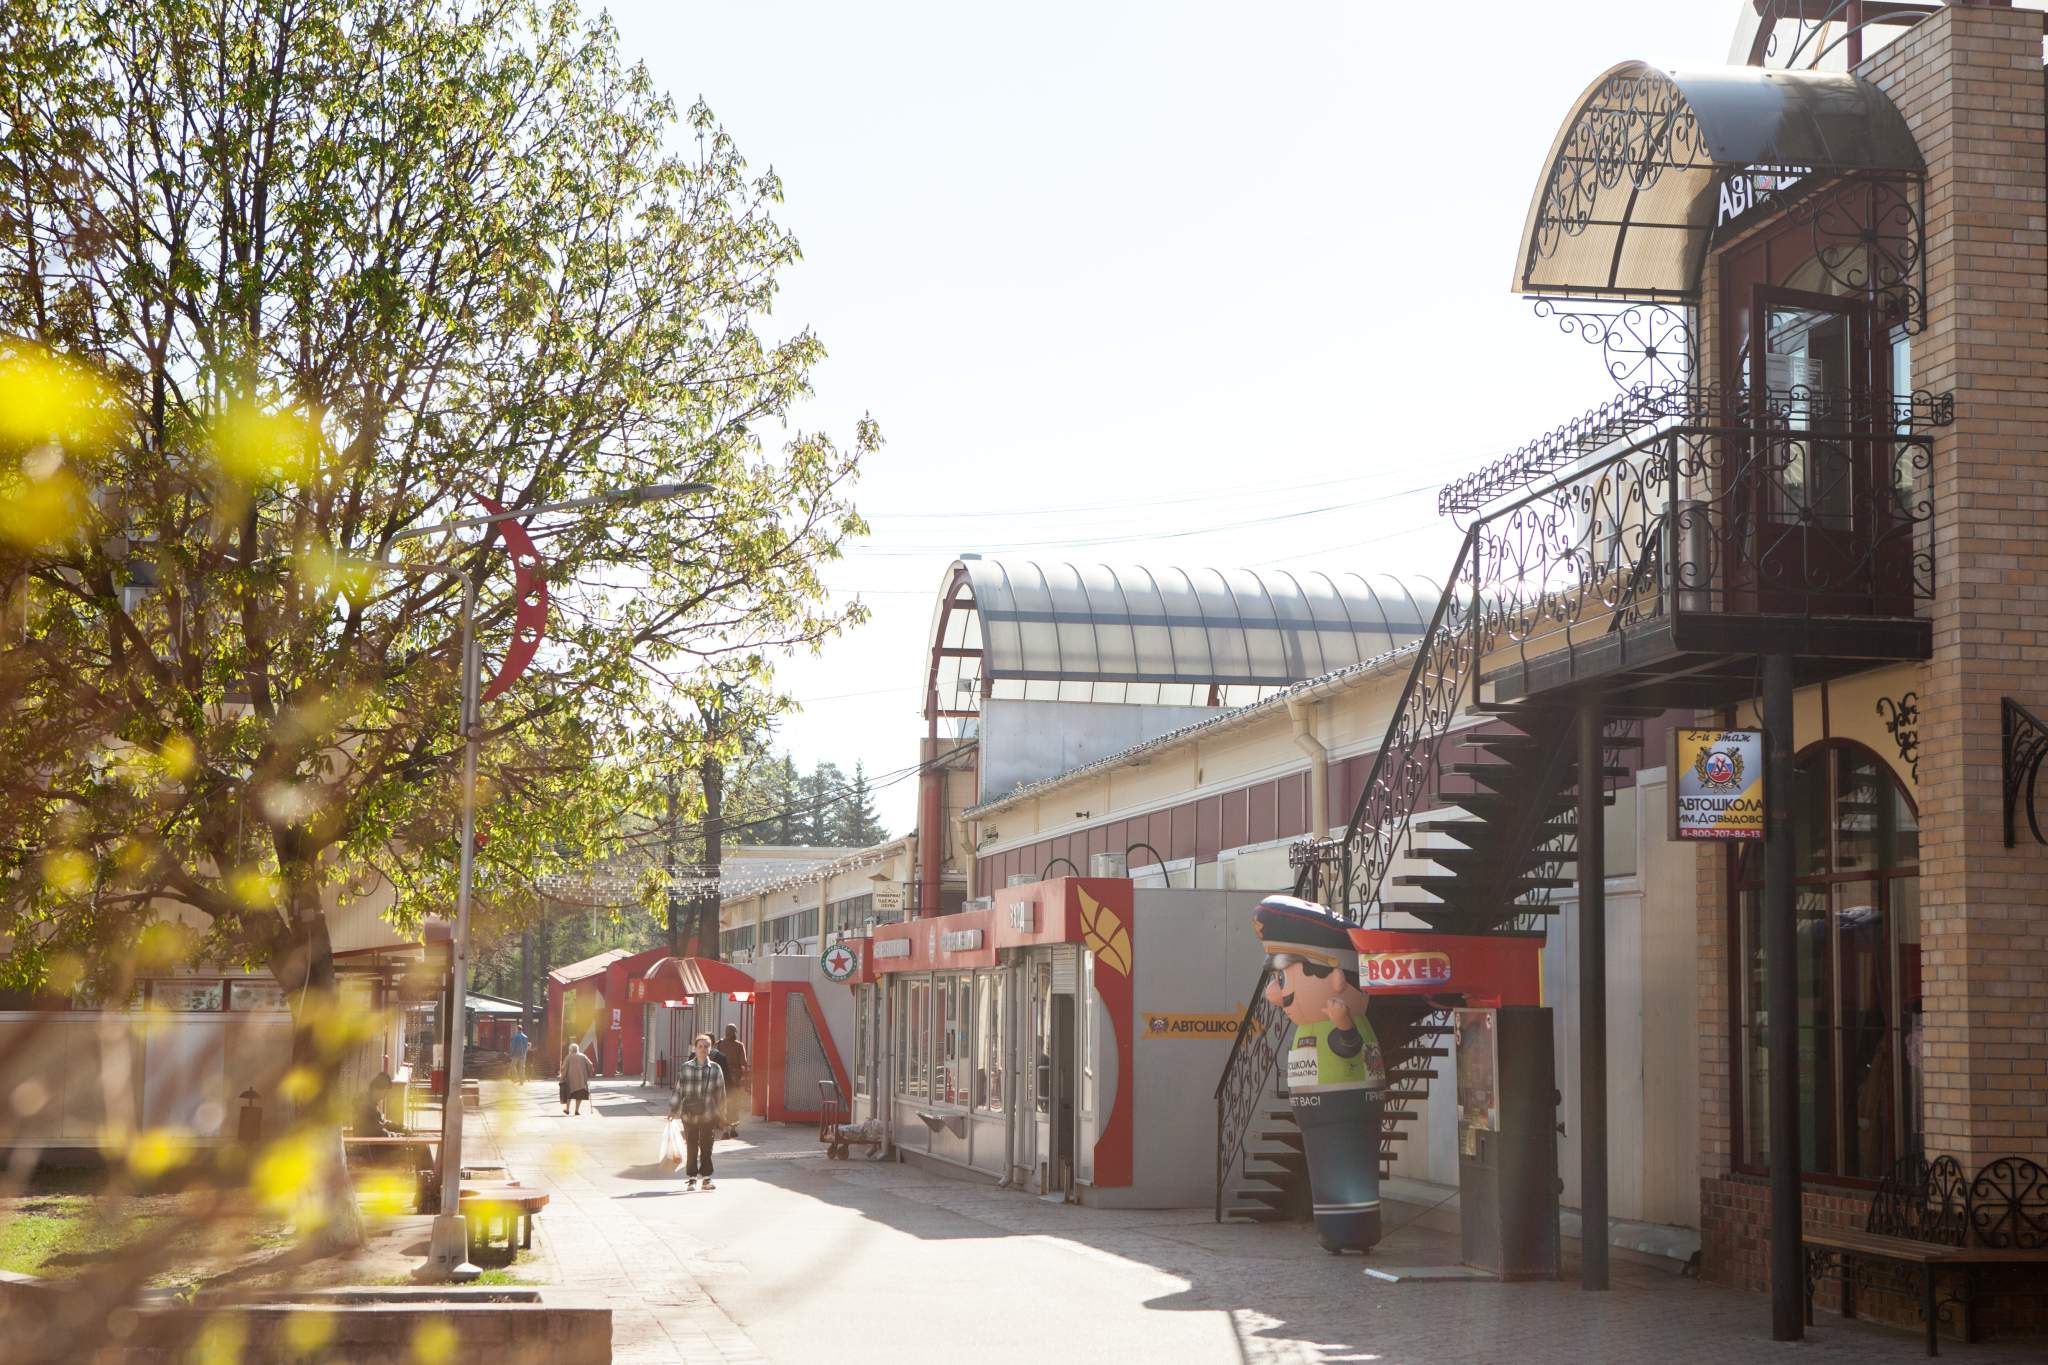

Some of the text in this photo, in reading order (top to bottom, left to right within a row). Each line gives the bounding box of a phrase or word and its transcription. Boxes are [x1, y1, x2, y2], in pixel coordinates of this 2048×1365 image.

[1680, 798, 1763, 811] АВТОШКОЛА
[1681, 829, 1760, 838] 8-800-707-86-13
[1367, 958, 1446, 980] BOXER
